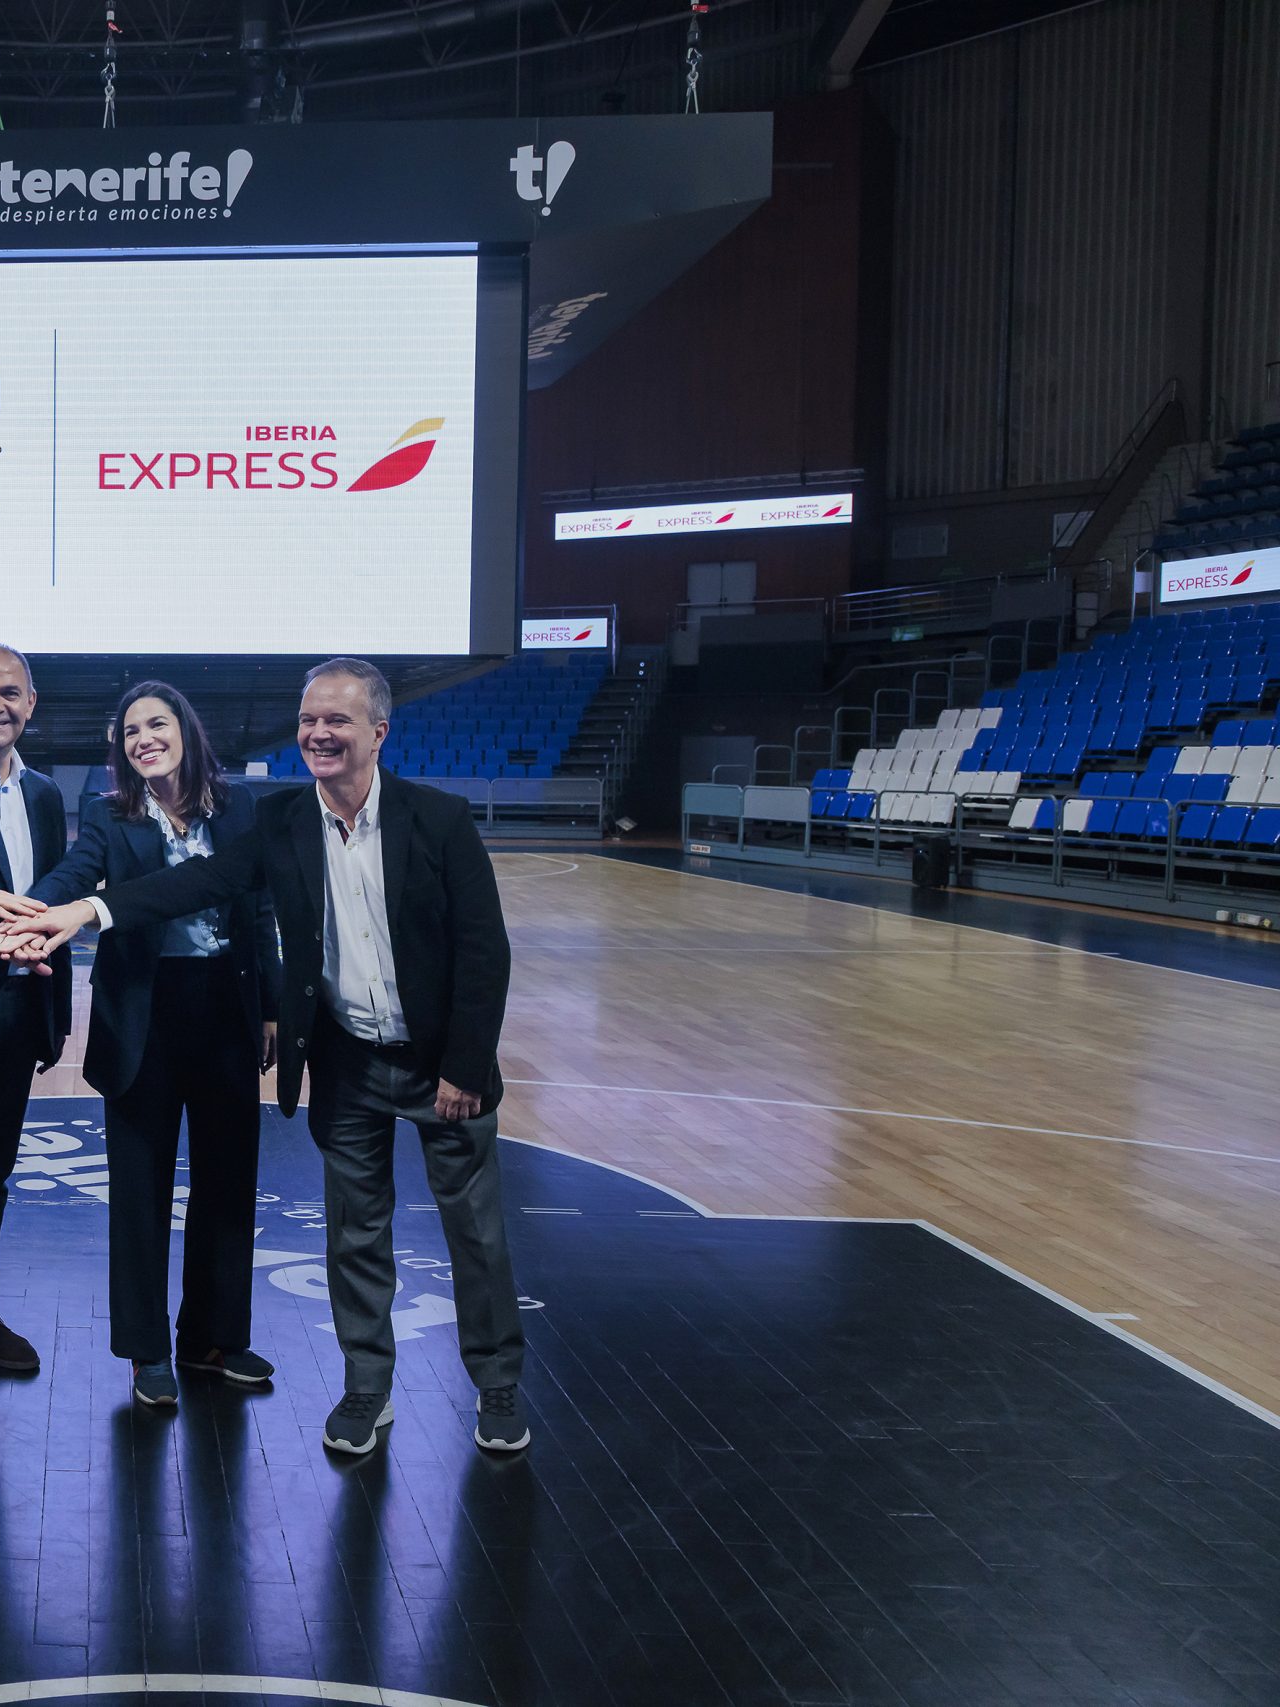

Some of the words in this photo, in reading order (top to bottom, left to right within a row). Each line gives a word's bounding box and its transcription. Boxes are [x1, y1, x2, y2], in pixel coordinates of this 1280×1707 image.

[0, 206, 98, 225] despierta
[246, 425, 337, 441] IBERIA
[98, 452, 339, 490] EXPRESS
[761, 508, 820, 521] EXPRESS
[561, 522, 613, 534] EXPRESS
[657, 515, 713, 528] EXPRESS
[1205, 565, 1228, 573] IBERIA
[1168, 574, 1228, 592] EXPRESS
[523, 632, 571, 642] XPRESS
